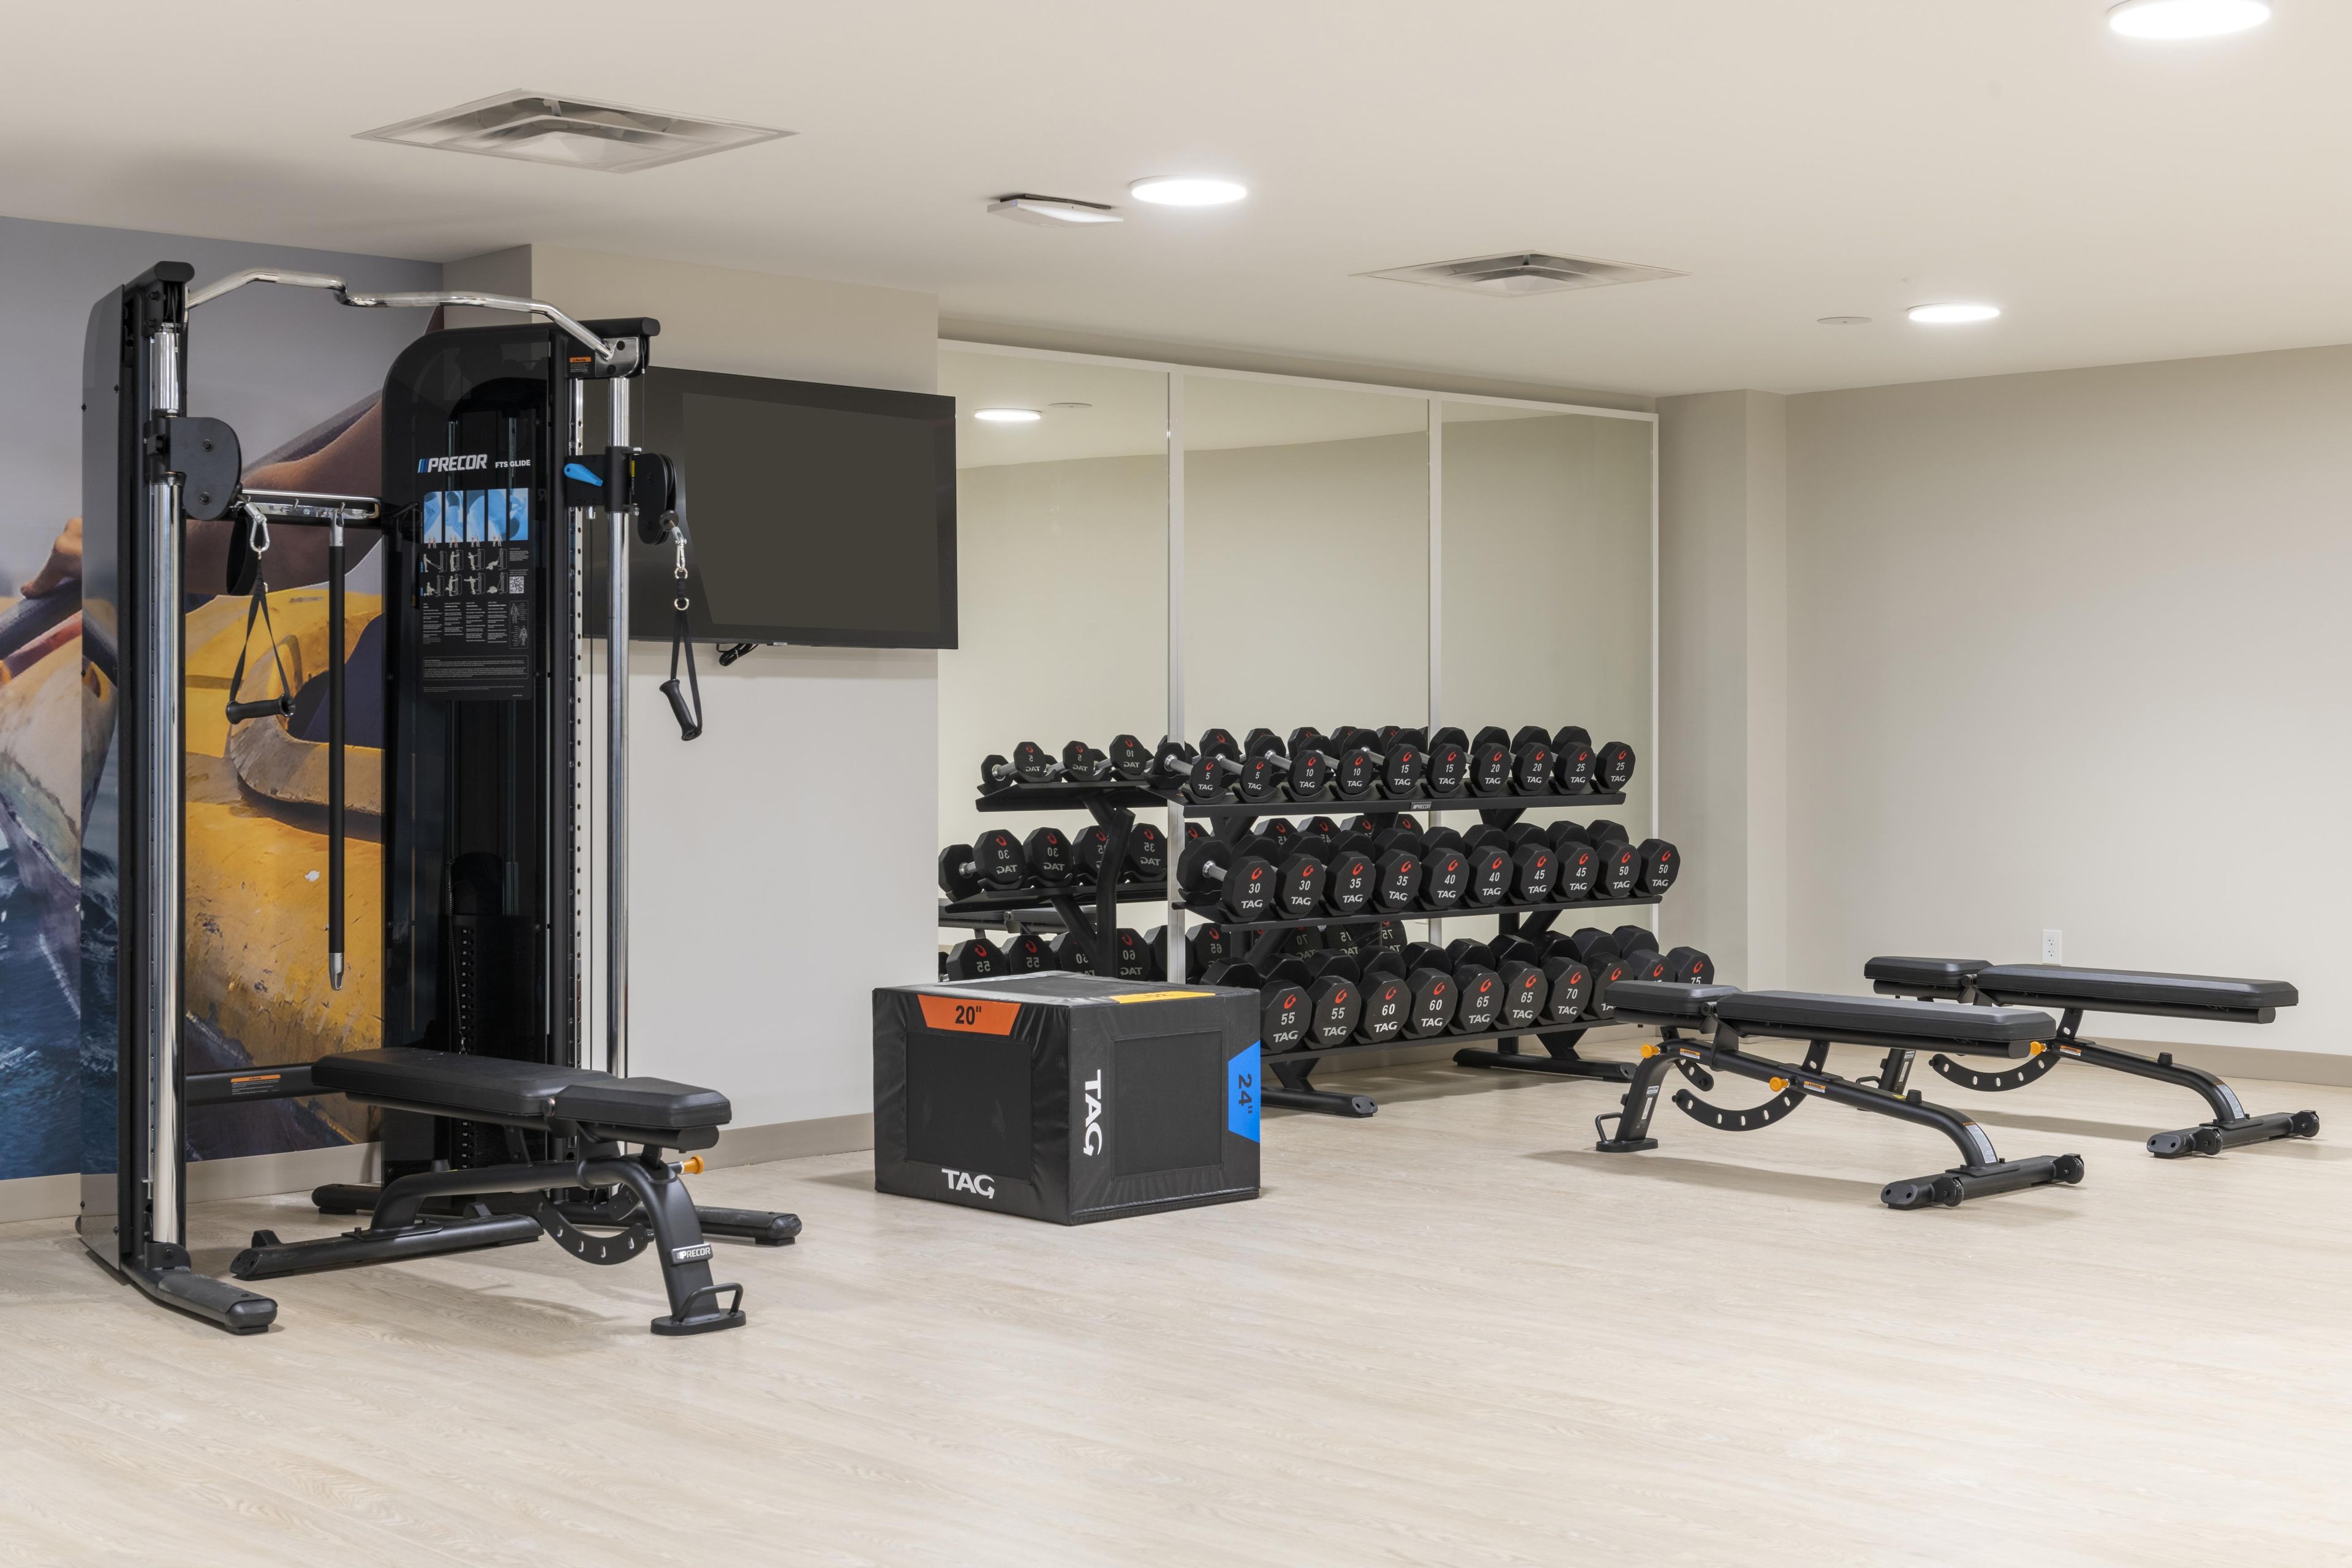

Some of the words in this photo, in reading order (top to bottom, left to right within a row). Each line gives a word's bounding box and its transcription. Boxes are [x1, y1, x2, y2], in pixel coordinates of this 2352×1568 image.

[427, 454, 488, 473] PRECOR
[1354, 767, 1361, 776] 10
[1401, 764, 1410, 774] 15
[1446, 764, 1454, 773] 15
[1490, 764, 1500, 773] 20
[1532, 763, 1542, 772] 20
[1576, 763, 1586, 772] 25
[1616, 762, 1625, 771] 25
[1306, 768, 1314, 777] 10
[1575, 867, 1587, 877] 45
[1619, 865, 1629, 876] 50
[1658, 864, 1668, 874] 50
[1444, 874, 1456, 884] 40
[1489, 872, 1500, 882] 40
[1534, 869, 1545, 880] 45
[1298, 880, 1311, 891] 30
[1349, 878, 1362, 889] 35
[1396, 875, 1409, 886] 35
[1613, 880, 1630, 889] TAG
[1248, 883, 1261, 894] 30
[1482, 887, 1502, 896] TAG
[1528, 884, 1547, 894] TAG
[1342, 894, 1363, 903] TAG
[1389, 891, 1408, 902] TAG
[1437, 890, 1457, 899] TAG
[1241, 899, 1264, 909] TAG
[1291, 896, 1312, 906] TAG
[1521, 992, 1534, 1003] 65
[1566, 988, 1578, 1000] 70
[1429, 999, 1442, 1011] 60
[1476, 995, 1490, 1008] 65
[1331, 1007, 1346, 1020] 55
[1382, 1003, 1395, 1016] 60
[1512, 1009, 1534, 1019] TAG
[1558, 1006, 1578, 1016] TAG
[954, 1005, 982, 1025] 20"
[1281, 1011, 1295, 1025] 55
[1468, 1014, 1491, 1024] TAG
[1374, 1021, 1398, 1033] TAG
[1421, 1017, 1444, 1027] TAG
[1322, 1026, 1347, 1036] TAG
[1273, 1030, 1298, 1043] TAG
[1237, 1072, 1253, 1115] 24"
[1084, 1069, 1102, 1156] TAG
[941, 1167, 995, 1199] TAG
[680, 1247, 710, 1259] PRECOR
